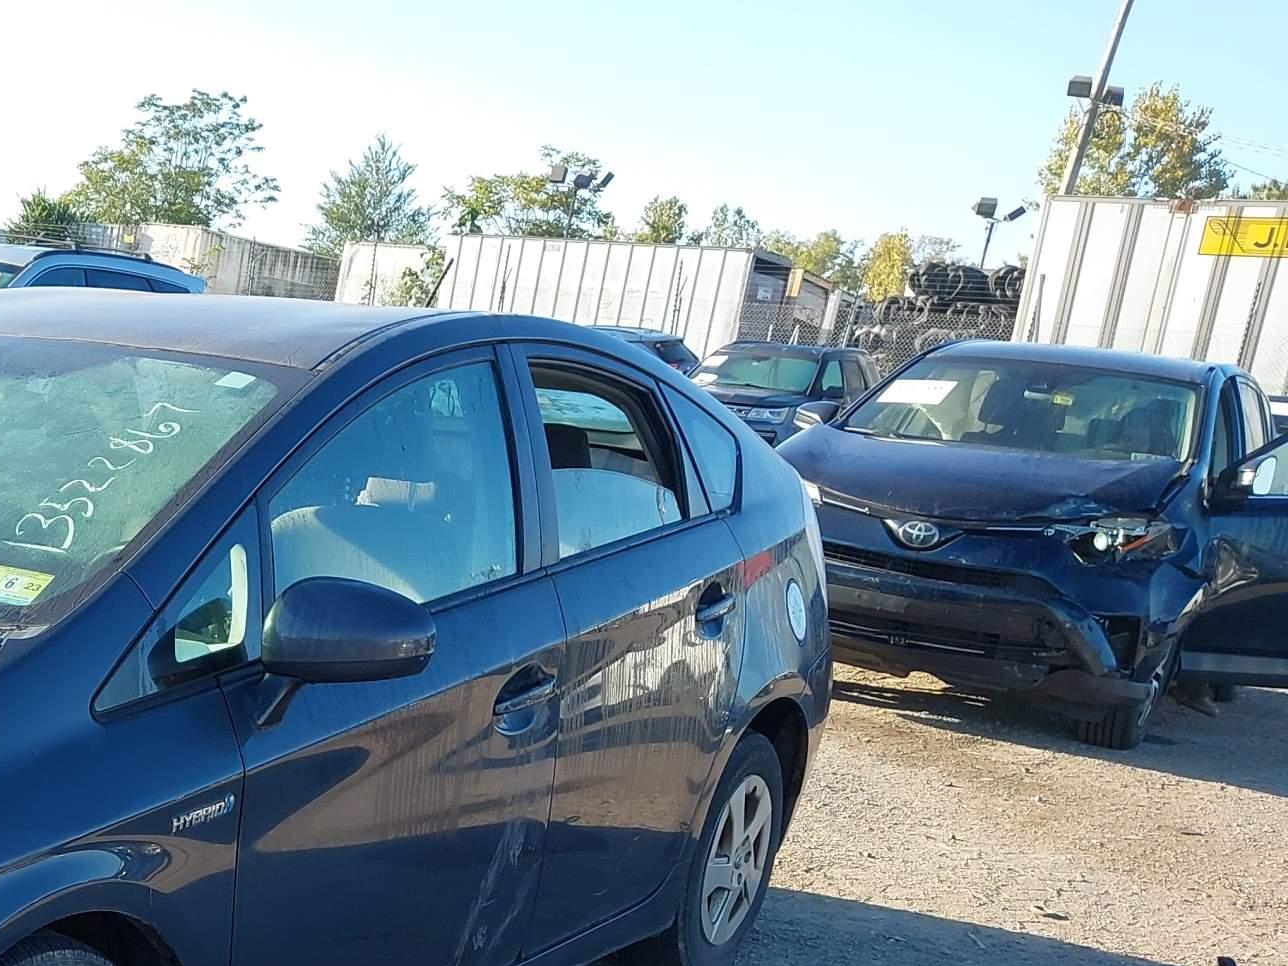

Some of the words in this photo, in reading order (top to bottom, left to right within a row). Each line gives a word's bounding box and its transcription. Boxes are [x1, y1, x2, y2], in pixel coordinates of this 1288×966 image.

[1253, 226, 1288, 249] J.
[4, 577, 18, 590] 6
[23, 582, 42, 592] 23
[171, 801, 226, 833] HYBRID
